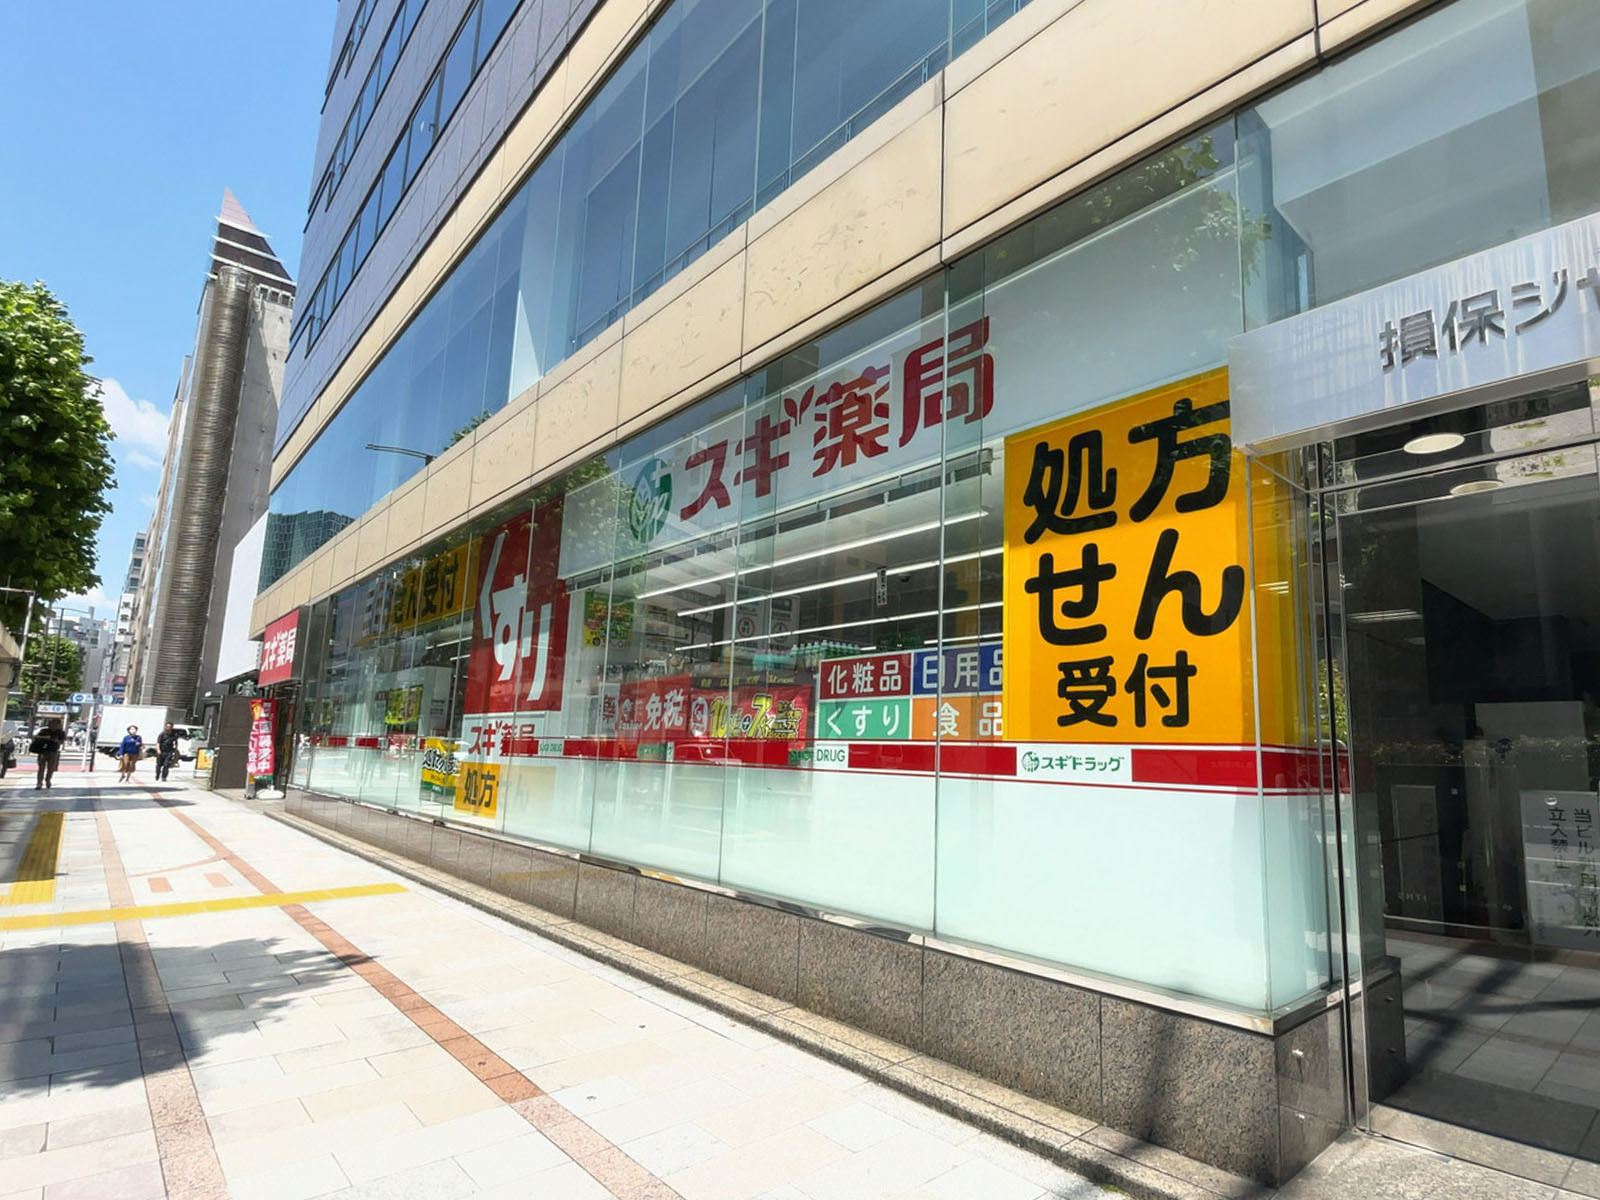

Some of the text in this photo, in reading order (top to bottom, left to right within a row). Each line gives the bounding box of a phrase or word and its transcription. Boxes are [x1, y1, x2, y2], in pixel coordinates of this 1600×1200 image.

[680, 316, 994, 522] スギ薬局
[1023, 398, 1232, 544] 処方
[1024, 528, 1245, 646] せん
[480, 531, 552, 702] くすり
[261, 627, 297, 672] スギ薬局
[828, 660, 901, 695] 化粧品
[1057, 650, 1198, 728] 受付
[644, 688, 684, 731] 免税
[827, 704, 900, 736] くすり
[932, 702, 1004, 737] 食品
[816, 749, 845, 762] DRUG
[1041, 755, 1125, 772] スギドラッグ
[1548, 807, 1570, 870] 立入禁止
